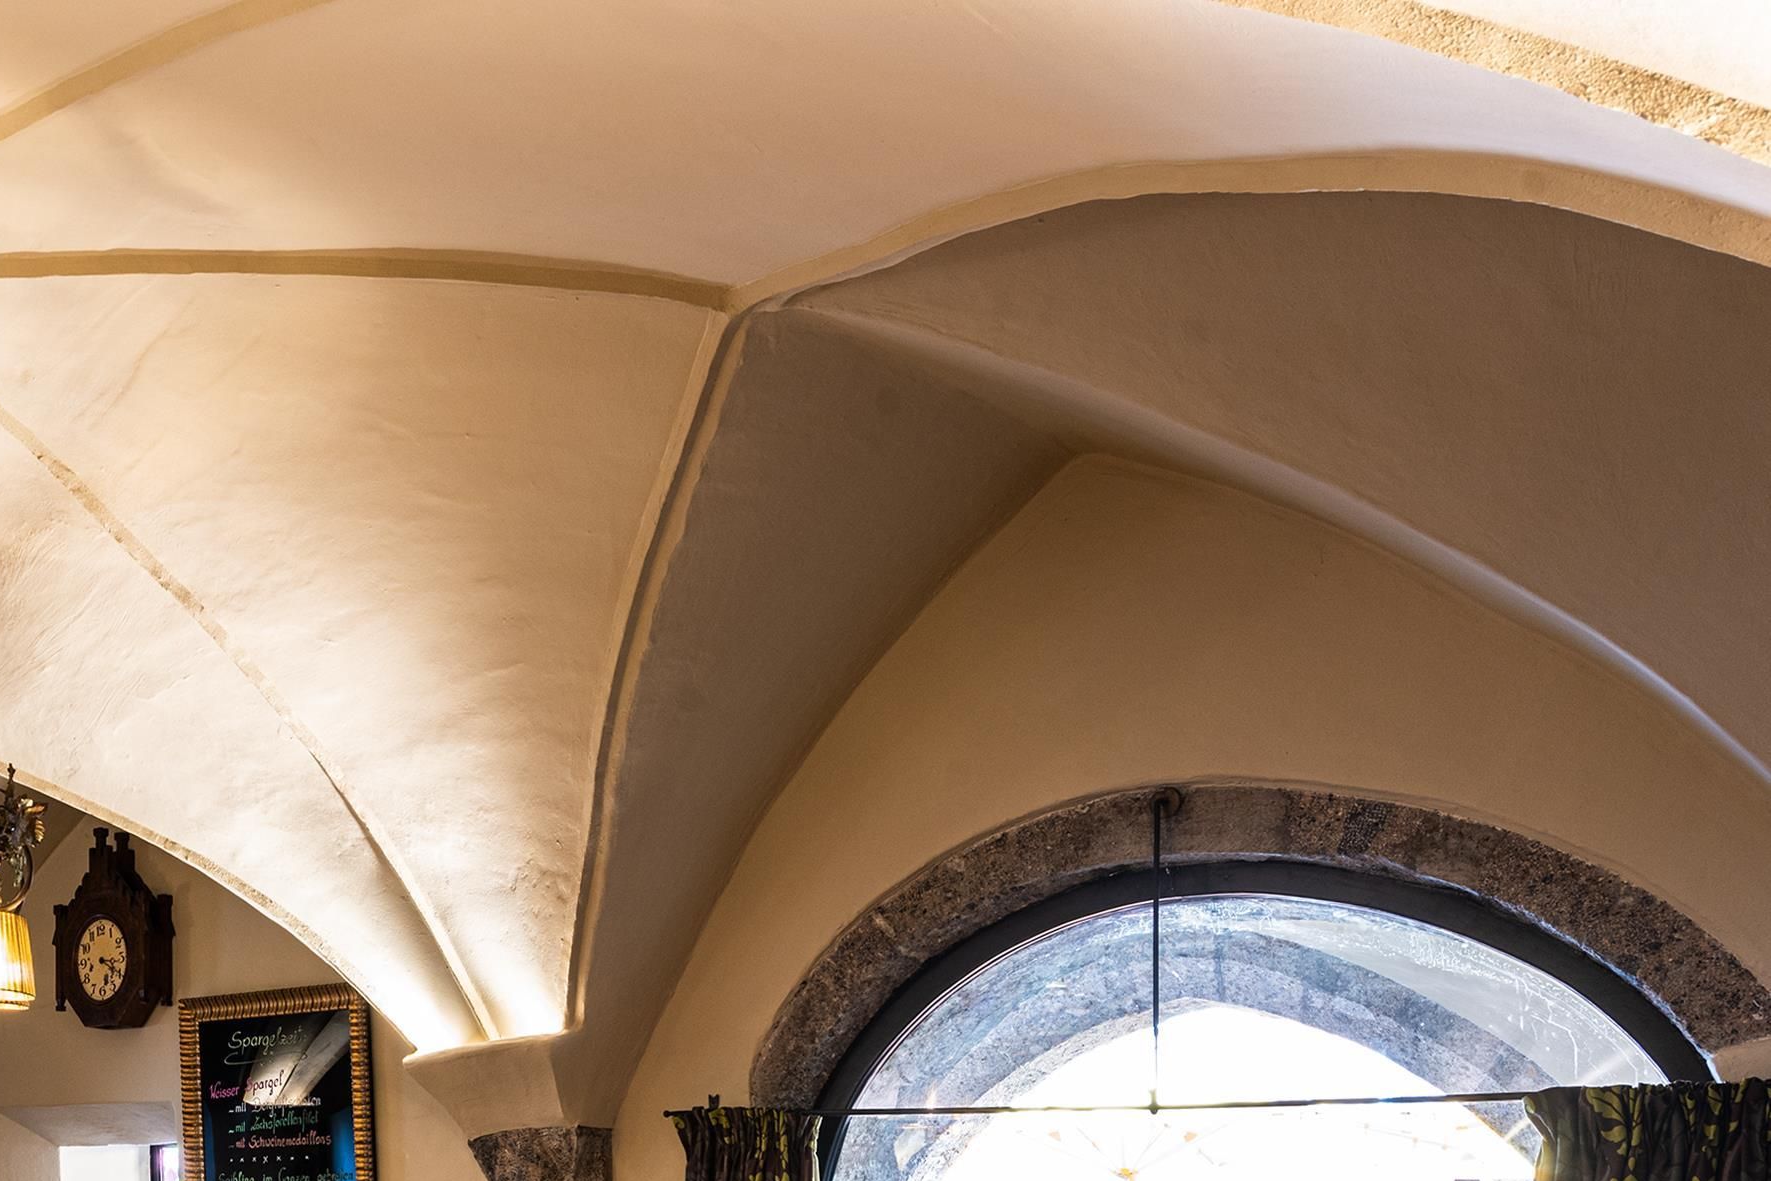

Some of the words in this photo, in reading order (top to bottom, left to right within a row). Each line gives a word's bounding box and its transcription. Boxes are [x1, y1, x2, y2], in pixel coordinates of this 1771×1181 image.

[96, 924, 105, 936] 12
[90, 931, 95, 942] 11
[115, 937, 122, 948] 2
[81, 943, 91, 954] 10
[80, 958, 87, 969] 9
[84, 973, 91, 984] 8
[91, 983, 97, 995] 7
[99, 985, 106, 997] 6
[209, 1081, 240, 1099] Weisser
[244, 1069, 284, 1095] Spargel
